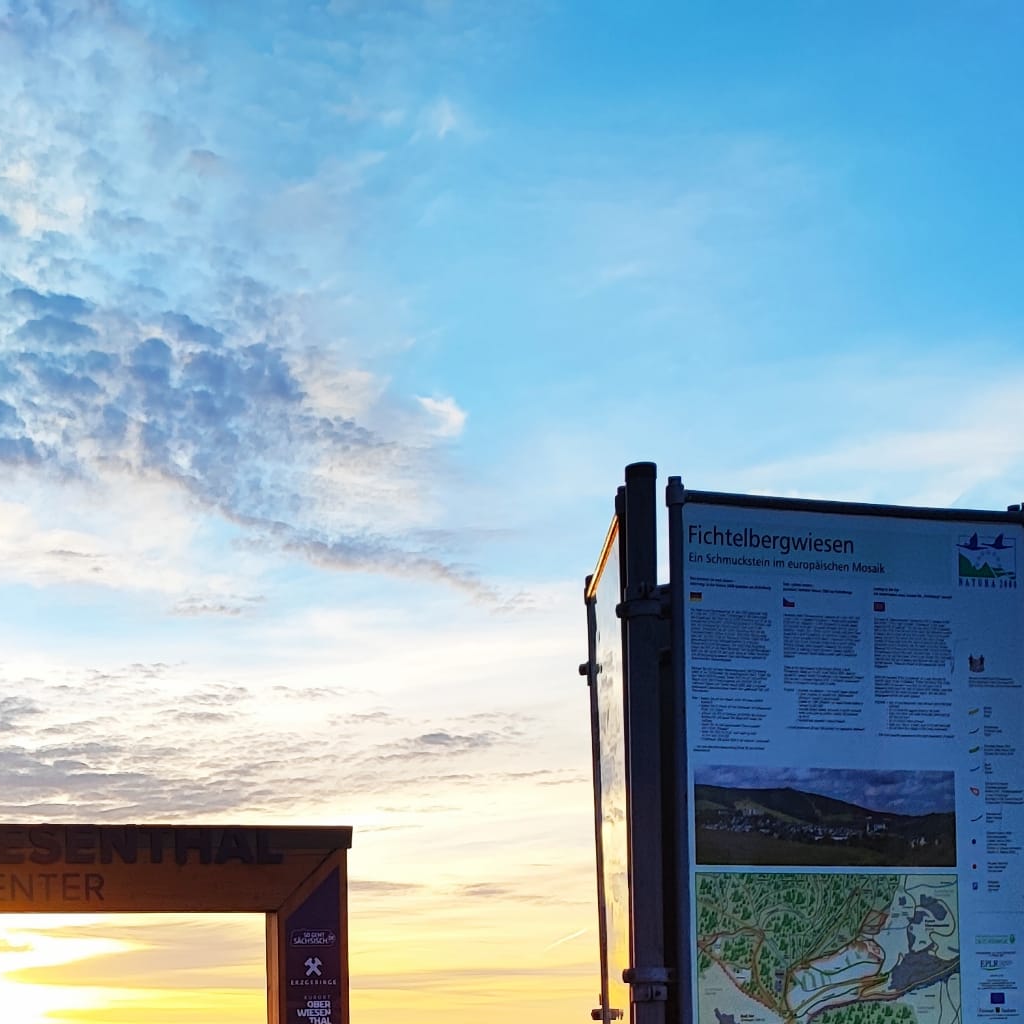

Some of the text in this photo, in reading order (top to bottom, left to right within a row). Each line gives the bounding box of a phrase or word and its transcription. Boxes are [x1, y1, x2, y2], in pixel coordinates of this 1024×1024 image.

[688, 525, 855, 554] Fichtelbergwiesen
[688, 552, 886, 574] Ein Schmuckstein im europäischen Mosaik
[958, 577, 996, 588] NATURA
[306, 1000, 331, 1008] OBER
[296, 1008, 332, 1017] WIESEN
[308, 1016, 332, 1024] THAL
